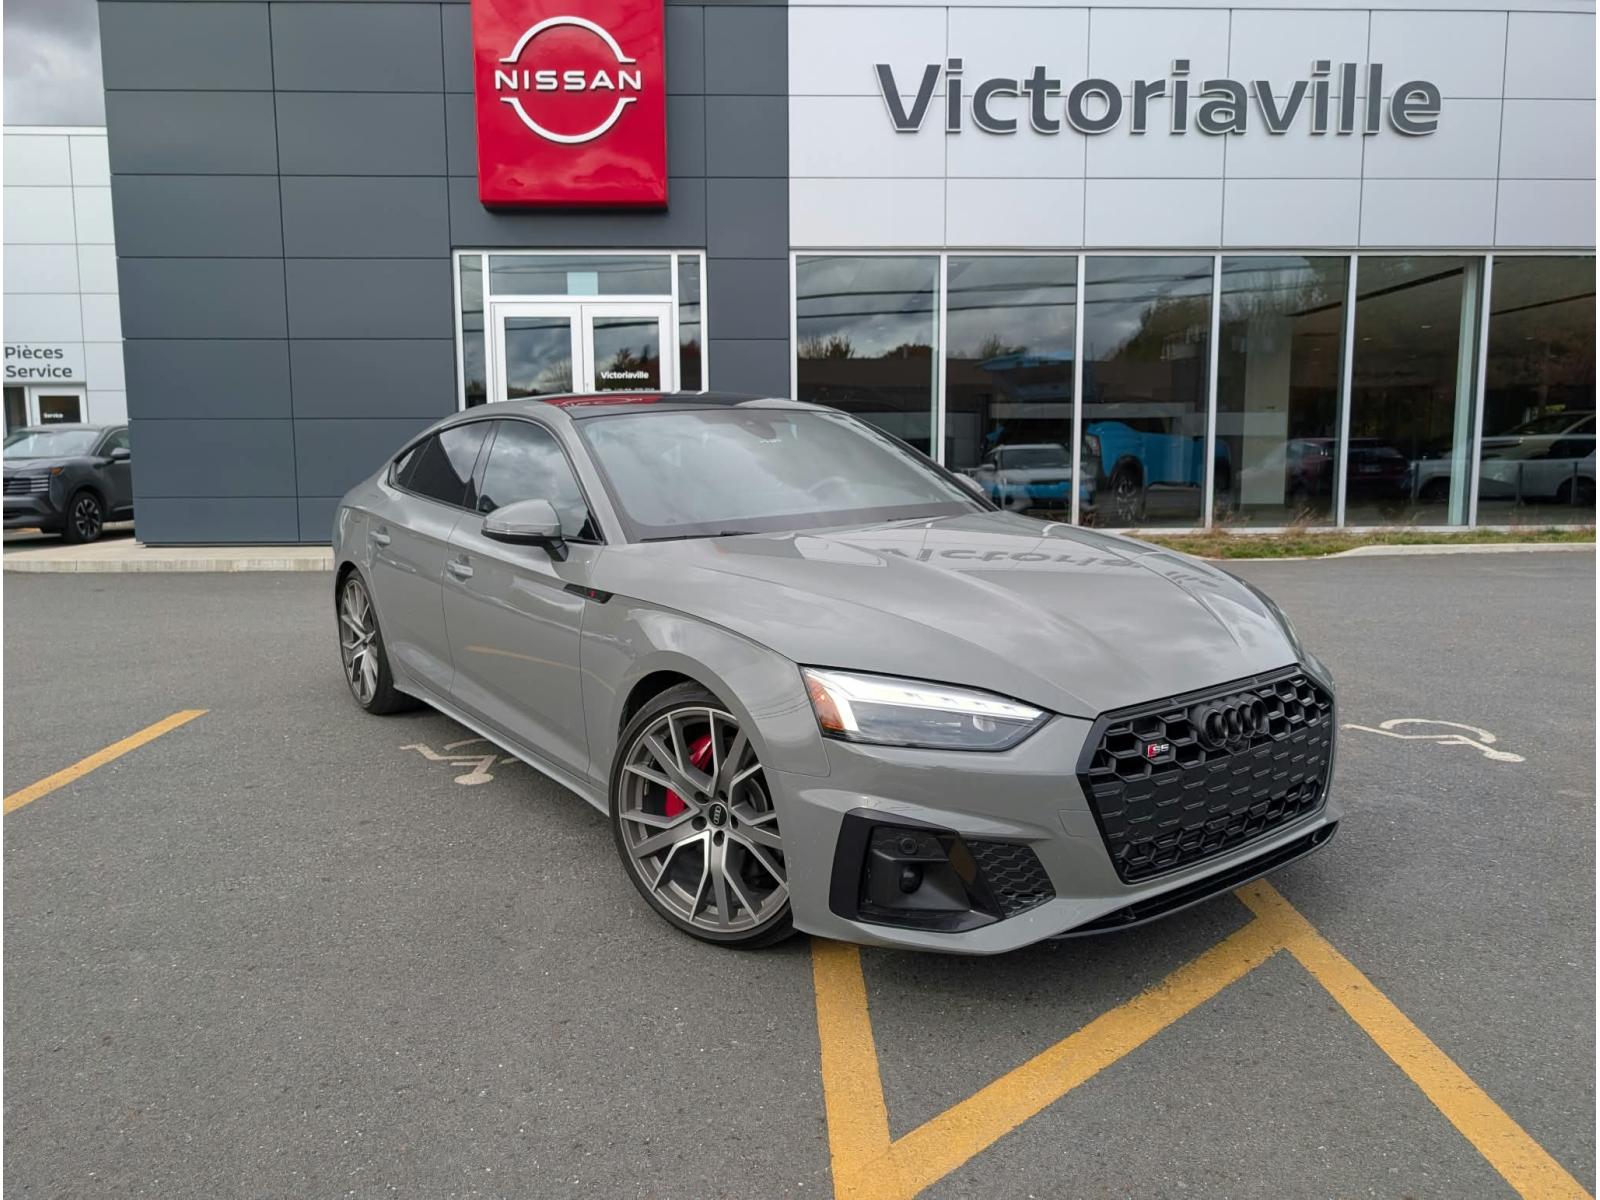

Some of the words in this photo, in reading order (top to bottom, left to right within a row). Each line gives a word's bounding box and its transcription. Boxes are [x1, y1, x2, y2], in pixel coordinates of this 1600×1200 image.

[494, 70, 642, 91] NISSAN
[875, 57, 1442, 136] Victoriaville
[4, 345, 63, 360] Pièces
[5, 364, 73, 378] Service
[600, 371, 650, 380] Victoriaville
